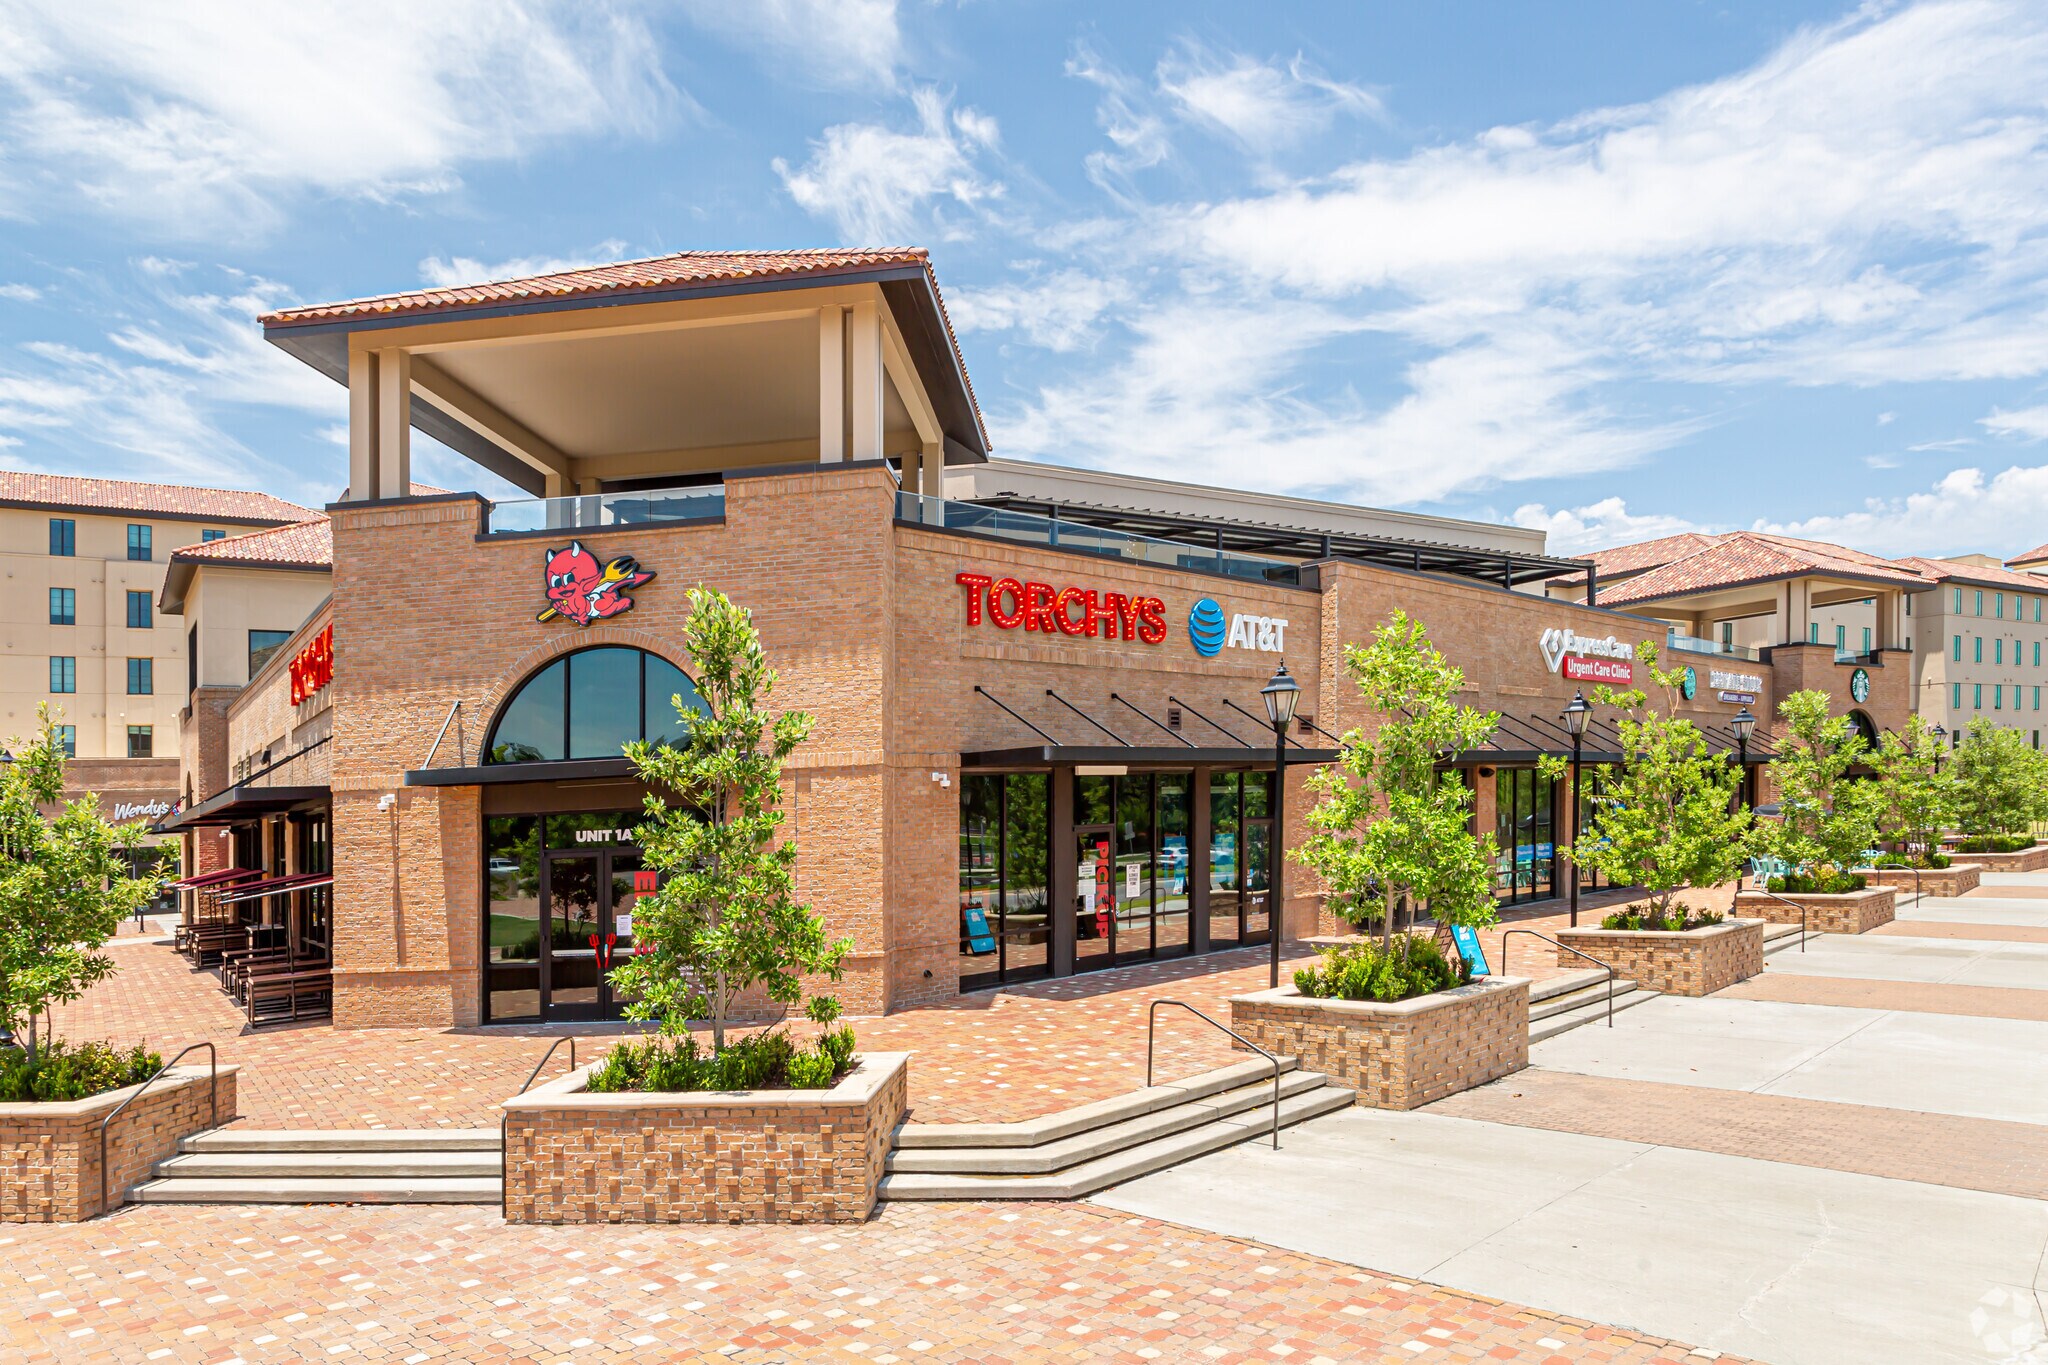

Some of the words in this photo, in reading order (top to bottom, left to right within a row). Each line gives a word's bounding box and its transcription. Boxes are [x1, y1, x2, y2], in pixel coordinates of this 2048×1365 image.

[956, 573, 1167, 645] TORCHYS
[1228, 613, 1288, 652] AT&T
[1563, 628, 1632, 659] ExpressCare
[1567, 658, 1593, 677] Urgent
[1594, 661, 1610, 677] Care
[1611, 663, 1631, 679] Clinic
[114, 799, 169, 820] Wendy's
[576, 829, 612, 842] UNIT
[615, 828, 633, 841] 1A
